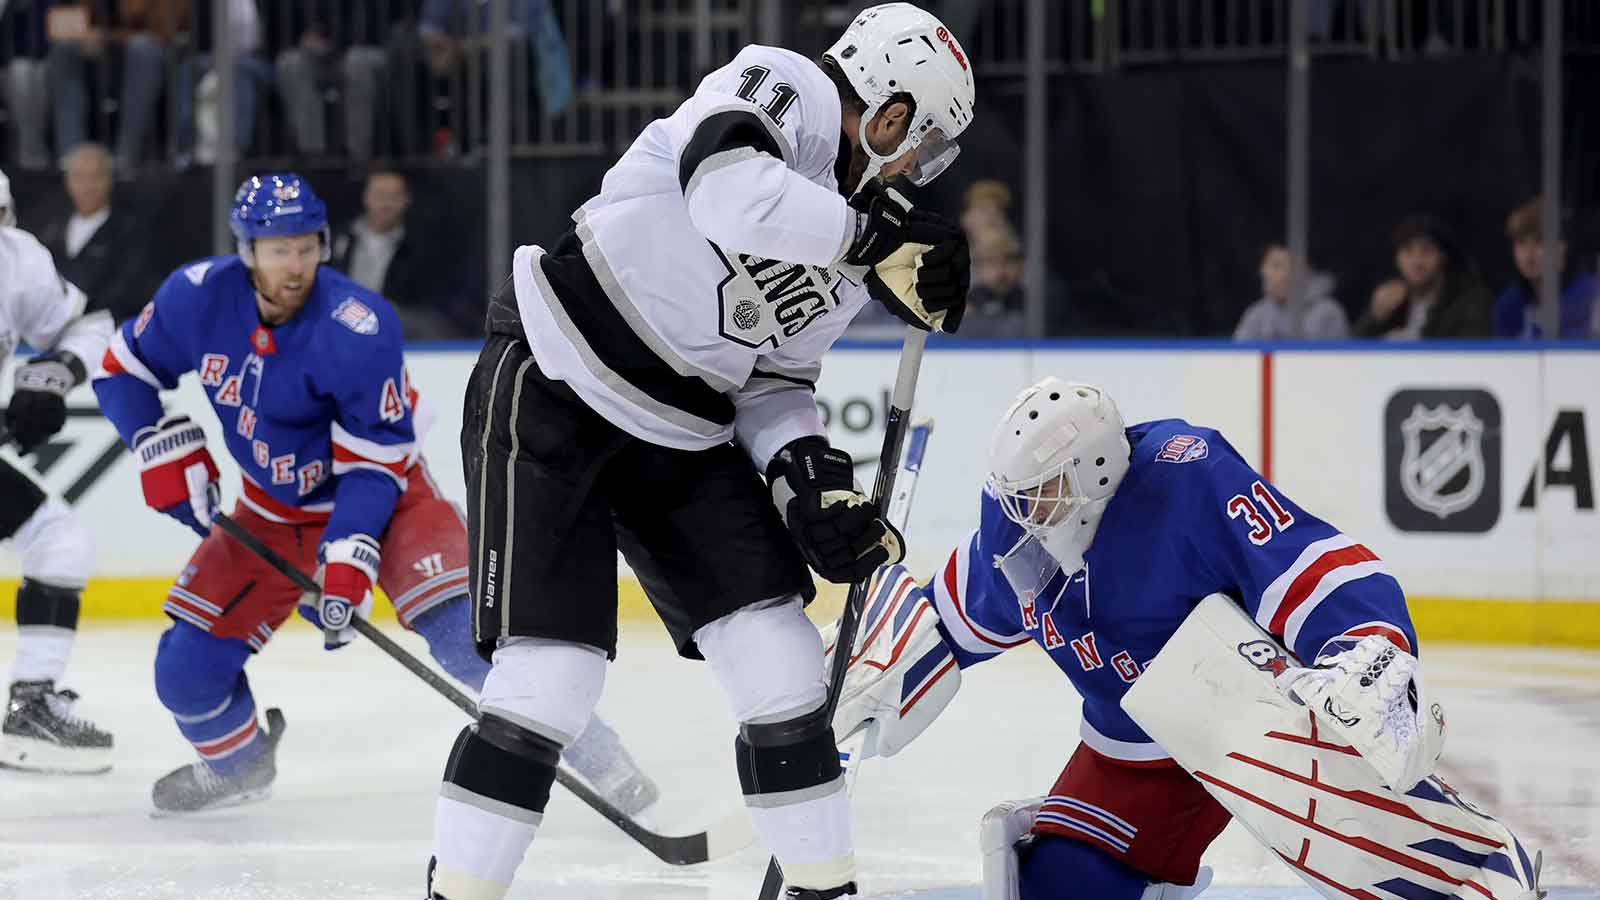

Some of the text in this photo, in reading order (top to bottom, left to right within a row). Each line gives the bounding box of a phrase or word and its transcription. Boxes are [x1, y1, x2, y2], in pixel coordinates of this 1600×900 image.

[735, 64, 799, 129] 11
[738, 253, 829, 338] INGS
[1161, 435, 1195, 461] 100
[1226, 479, 1295, 546] 31
[1018, 589, 1152, 684] RANG
